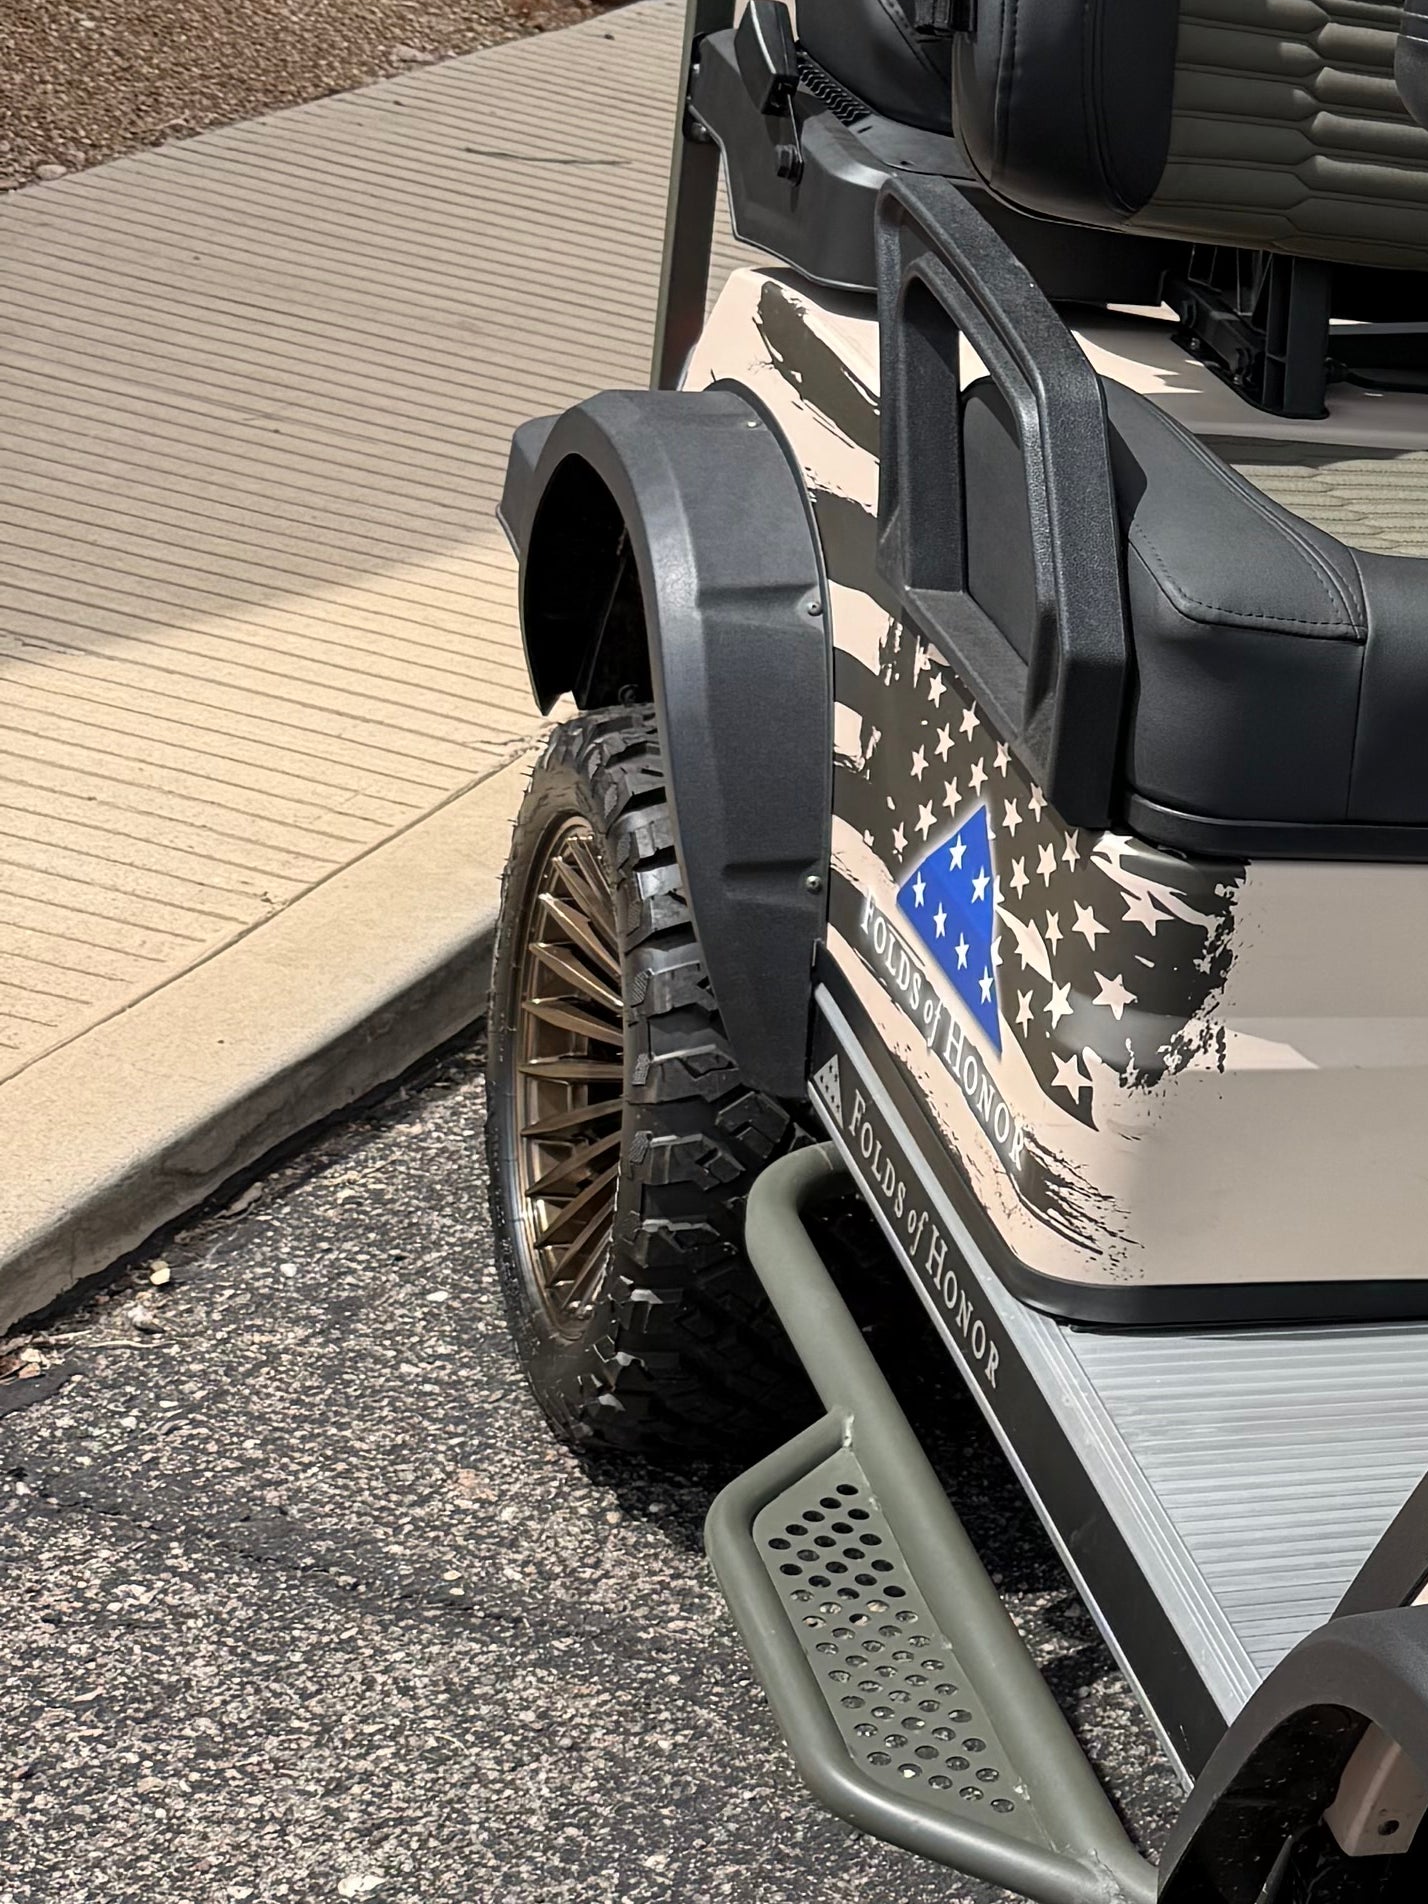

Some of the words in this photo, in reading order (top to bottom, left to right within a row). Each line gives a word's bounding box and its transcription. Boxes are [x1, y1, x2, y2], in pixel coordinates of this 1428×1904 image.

[860, 890, 922, 1011] FOLDS
[923, 997, 943, 1048] of
[942, 1016, 1022, 1172] HONOR
[848, 1088, 906, 1218] FOLDS
[907, 1208, 929, 1256] of
[925, 1224, 999, 1389] HONOR
